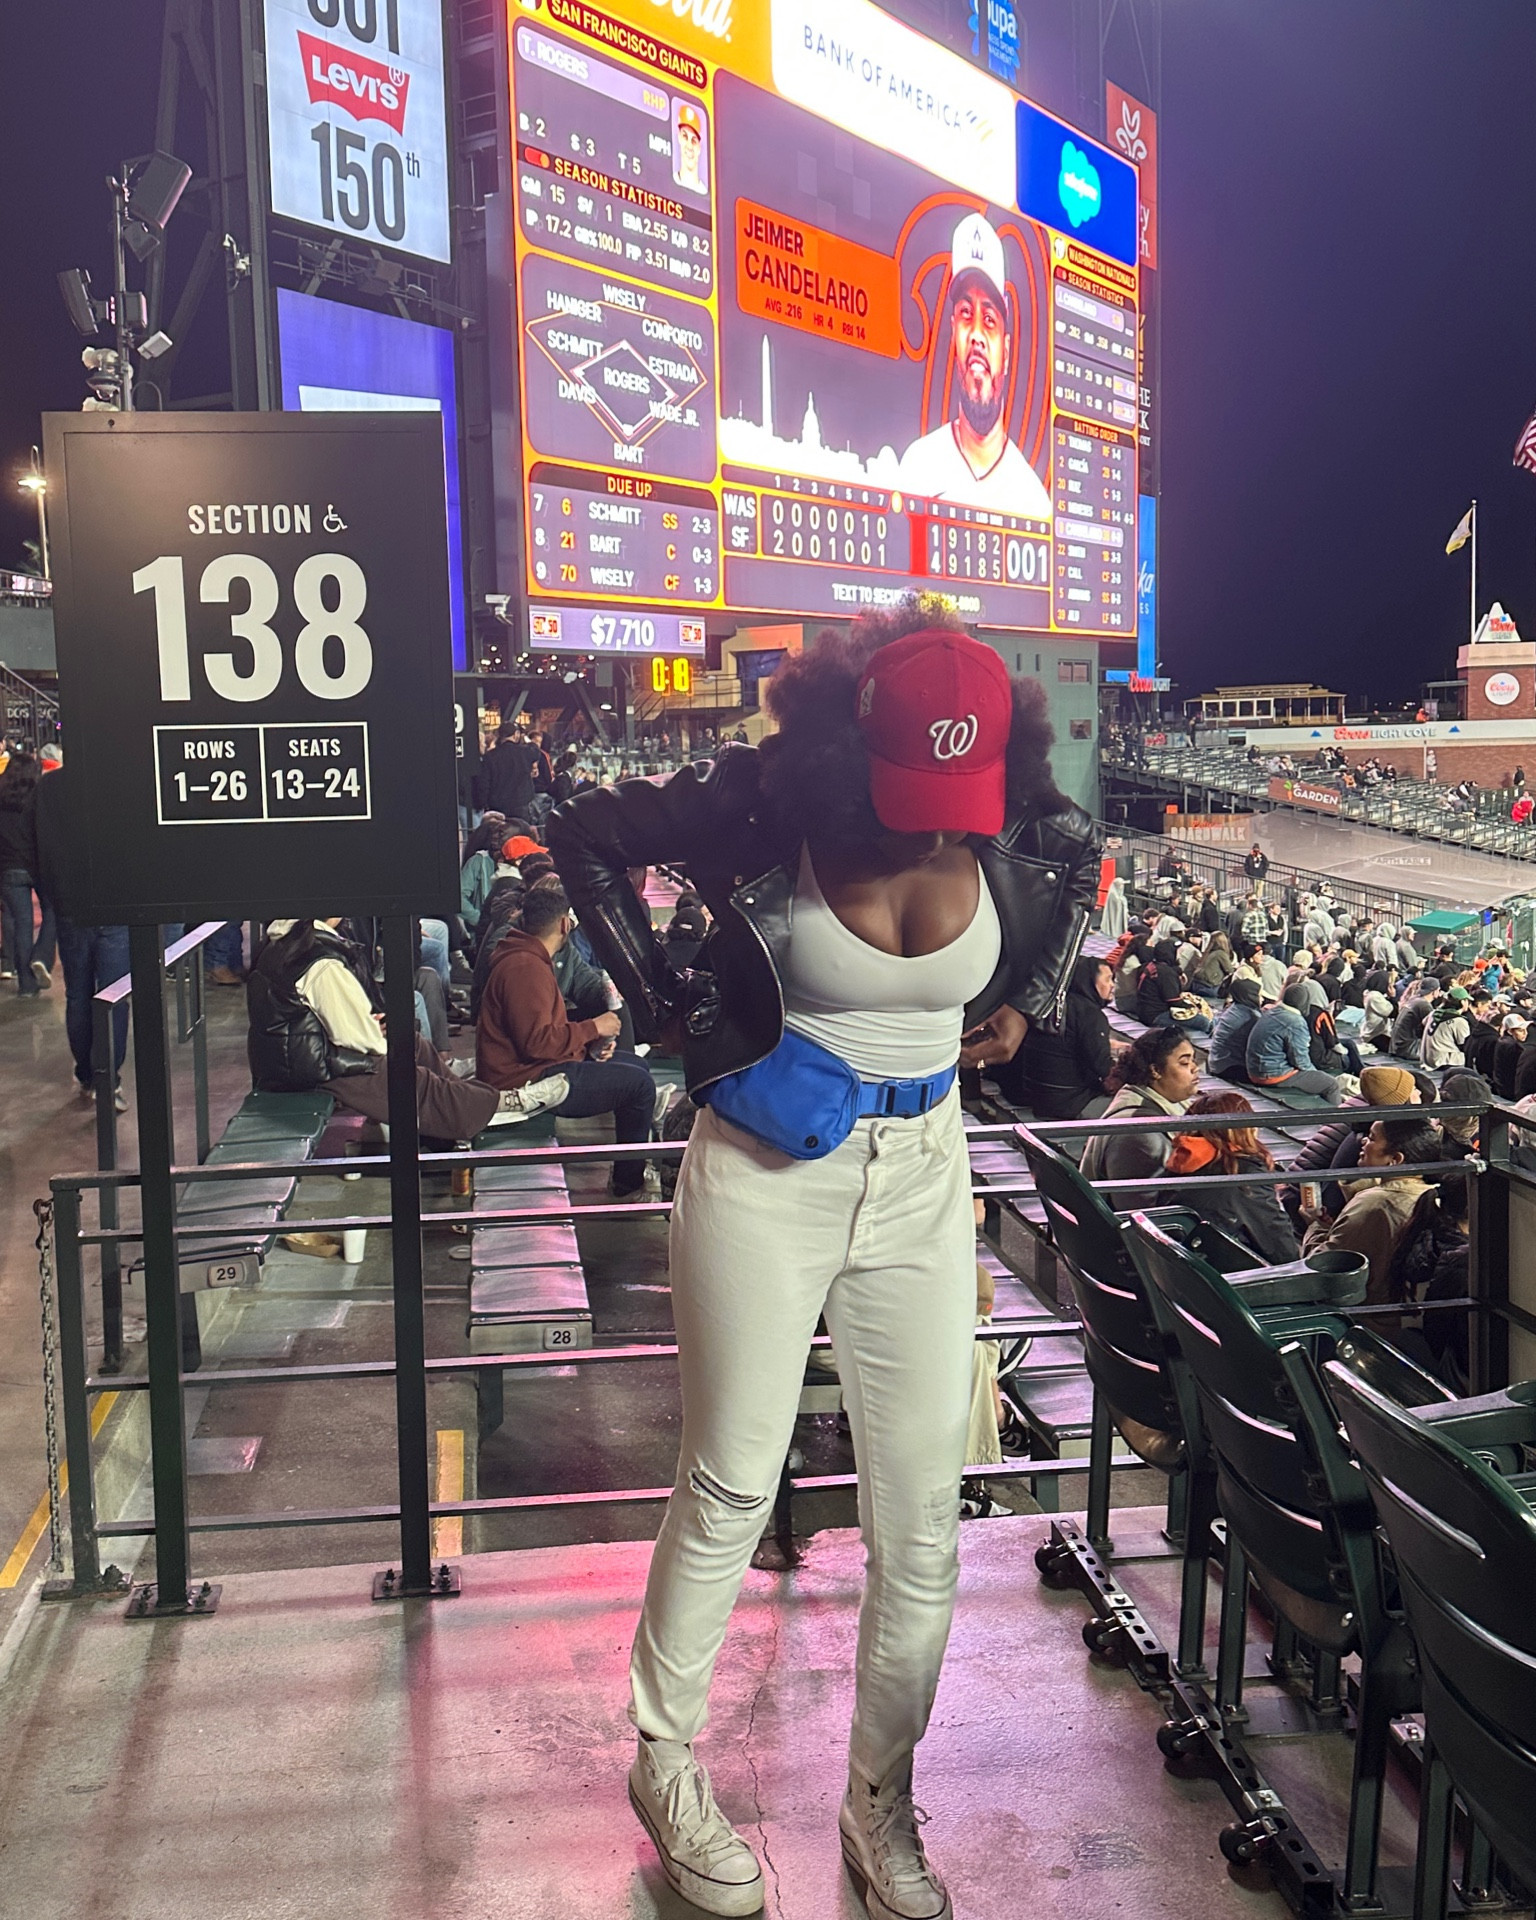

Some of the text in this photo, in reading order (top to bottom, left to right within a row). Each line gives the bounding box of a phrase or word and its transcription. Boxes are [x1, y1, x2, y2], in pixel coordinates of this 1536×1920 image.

[521, 34, 588, 80] T. ROGERS
[551, 0, 581, 26] SAN
[583, 10, 657, 61] FRANCISCO
[660, 50, 704, 84] GIANTS
[803, 24, 962, 129] BANK OF AMERICA
[643, 90, 667, 111] RHP
[535, 118, 546, 137] 2
[586, 138, 595, 156] 3
[633, 157, 641, 175] 5
[555, 158, 683, 220] SEASON STATISTICS
[550, 184, 566, 204] 15
[605, 204, 613, 222] 1
[644, 222, 668, 242] 2.55
[692, 237, 710, 256] 8.2
[546, 214, 572, 239] 17.2
[597, 232, 622, 255] 100.0
[645, 249, 668, 270] 3.51
[693, 264, 710, 284] 2.0
[744, 213, 804, 258] JEIMER
[603, 284, 646, 312] WISELY
[745, 249, 868, 318] CANDELARIO
[1068, 272, 1091, 292] SEASON
[1092, 283, 1124, 306] STATISTICS
[765, 297, 782, 313] AVG
[784, 303, 803, 320] .216
[814, 312, 824, 328] HR
[827, 317, 833, 330] 4
[856, 326, 866, 340] 14
[547, 330, 603, 357] SCHMITT
[642, 319, 702, 350] CONFORTO
[604, 367, 650, 394] ROGERS
[649, 356, 698, 384] ESTRADA
[558, 380, 596, 404] DAVIS
[649, 401, 682, 423] WADE
[1100, 428, 1118, 443] ORDER
[614, 443, 644, 463] BART
[607, 476, 652, 497] DUE UP
[775, 475, 781, 488] 1
[793, 478, 800, 491] 2
[811, 482, 818, 494] 3
[829, 485, 835, 497] 4
[846, 488, 852, 500] 5
[878, 494, 884, 506] 7
[188, 504, 312, 534] SECTION
[533, 494, 711, 534] 7 6 SCHMITT SS 2-3
[723, 493, 1000, 555] WAS 0 0 0 0 0 1 0 1 9 1 8 2
[535, 527, 712, 565] 8 21 BART C 0-3
[732, 526, 1000, 579] SF 2 0 0 1 0 0 1 4 9 1 8 5
[535, 561, 712, 594] 9 70 WISELY CF 1-3
[832, 583, 857, 602] TEXT
[858, 585, 872, 603] TO
[1139, 602, 1150, 615] ES
[132, 553, 373, 702] 138
[591, 615, 655, 650] $7,710
[184, 738, 341, 759] ROWS SEATS
[928, 714, 979, 760] W
[1334, 726, 1436, 741] Coors LIGHT COVE
[173, 768, 361, 802] 1-26 13-24
[1293, 788, 1338, 805] GARDEN
[1170, 826, 1246, 842] BOARDWALK
[216, 1267, 237, 1281] 29
[552, 1331, 571, 1344] 28
